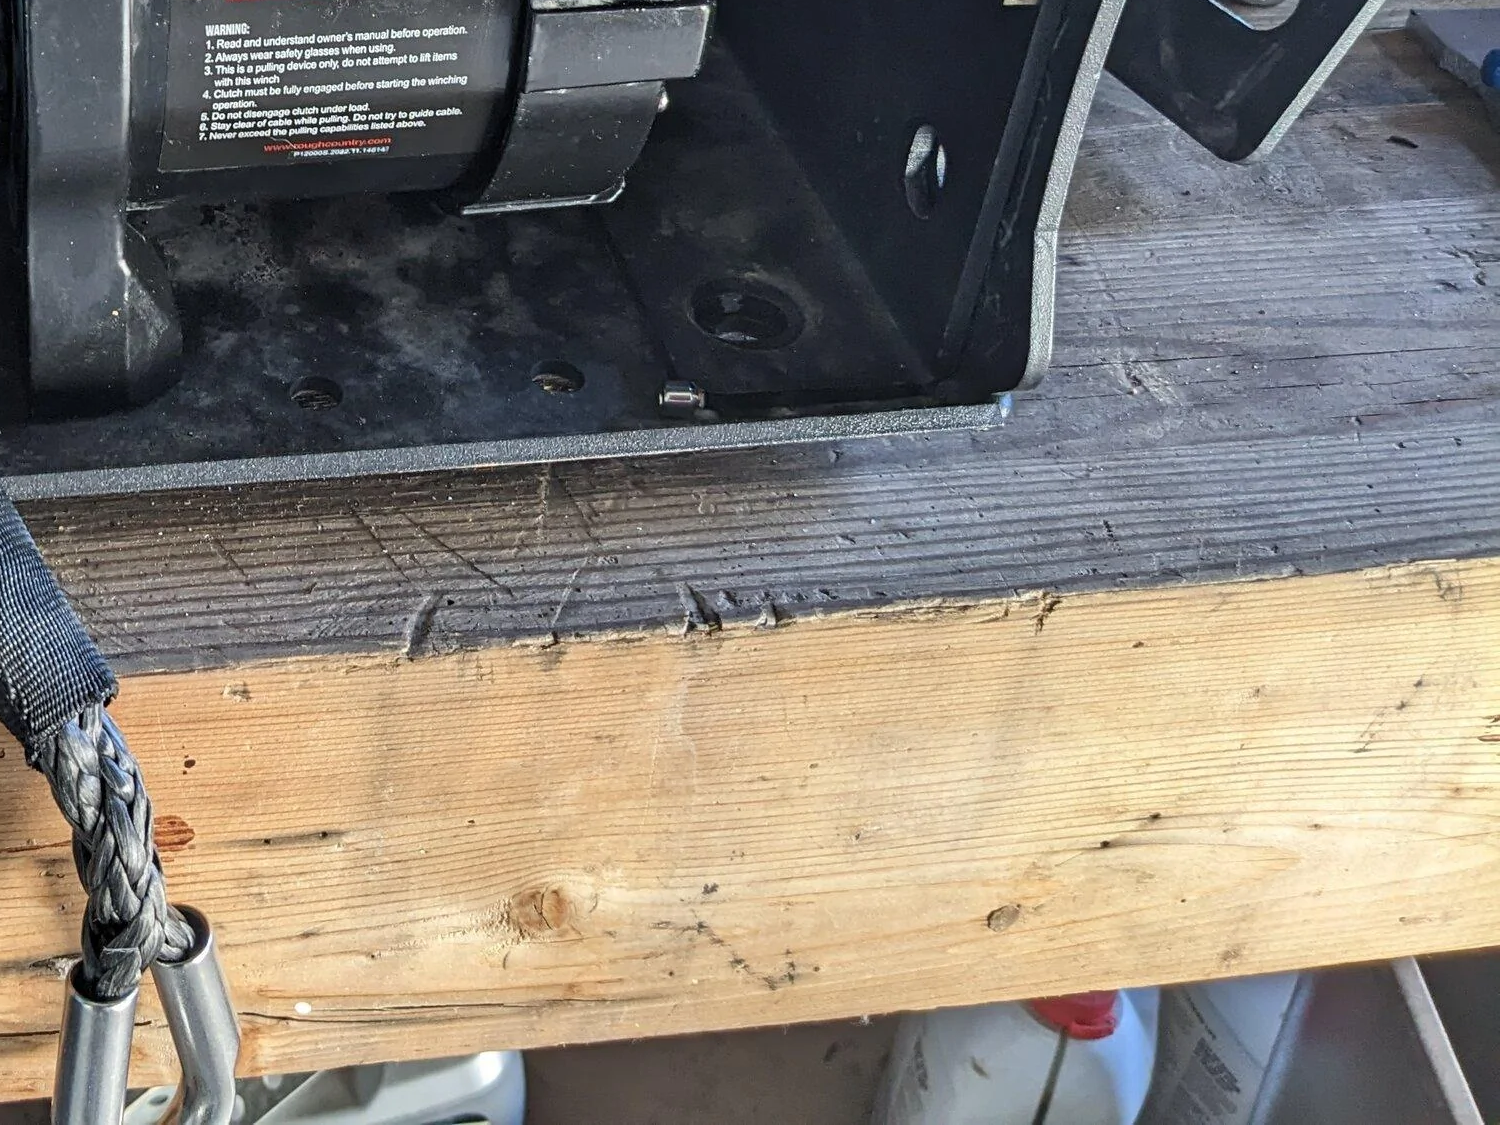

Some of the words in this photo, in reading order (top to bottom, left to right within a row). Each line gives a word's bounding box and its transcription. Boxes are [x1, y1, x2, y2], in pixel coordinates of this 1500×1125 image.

[205, 23, 251, 36] WARNING:
[205, 40, 215, 50] 1.
[216, 38, 242, 49] Read
[243, 37, 261, 48] and
[263, 34, 315, 47] understand
[316, 32, 353, 44] owner's
[354, 29, 390, 41] manual
[390, 27, 420, 39] before
[422, 24, 468, 39] operation.
[204, 53, 214, 63] 2.
[215, 52, 249, 63] Always
[249, 51, 273, 60] wear
[275, 48, 303, 60] safety
[304, 46, 340, 59] glasses
[341, 44, 367, 55] when
[368, 43, 397, 55] using.
[203, 65, 213, 76] 3.
[214, 64, 235, 75] This
[236, 64, 245, 74] is
[255, 62, 285, 74] pulling
[286, 60, 317, 71] device
[341, 58, 355, 68] do
[356, 56, 371, 67] not
[372, 54, 407, 66] attempt
[408, 53, 419, 63] to
[419, 52, 431, 63] lift
[432, 52, 458, 62] items
[202, 90, 212, 100] 4.
[213, 88, 243, 99] Clutch
[244, 87, 268, 97] must
[269, 86, 281, 95] be
[283, 85, 301, 96] fully
[303, 82, 344, 95] engaged
[345, 81, 375, 91] before
[376, 79, 410, 89] starting
[411, 77, 426, 87] the
[428, 75, 468, 86] winching
[214, 76, 233, 87] with
[235, 76, 251, 86] this
[253, 74, 280, 85] winch
[200, 112, 210, 122] 5.
[211, 111, 225, 121] Do
[226, 110, 243, 121] not
[243, 108, 290, 119] disengage
[291, 106, 319, 116] clutch
[320, 104, 348, 115] under
[348, 102, 370, 112] load.
[212, 100, 258, 111] operation.
[199, 122, 209, 132] 6.
[210, 121, 231, 131] Stay
[232, 119, 256, 130] clear
[256, 118, 267, 128] of
[268, 117, 292, 127] cable
[294, 115, 318, 126] while
[318, 114, 351, 125] pulling.
[353, 113, 367, 122] Do
[368, 112, 383, 121] not
[384, 110, 398, 121] try
[398, 110, 407, 119] to
[408, 108, 434, 119] guide
[435, 106, 462, 117] cable.
[198, 132, 208, 142] 7.
[209, 131, 237, 141] Never
[238, 129, 271, 139] exceed
[272, 127, 288, 137] the
[288, 126, 318, 137] pulling
[319, 123, 370, 135] capabilities
[370, 121, 394, 131] listed
[395, 119, 426, 129] above.
